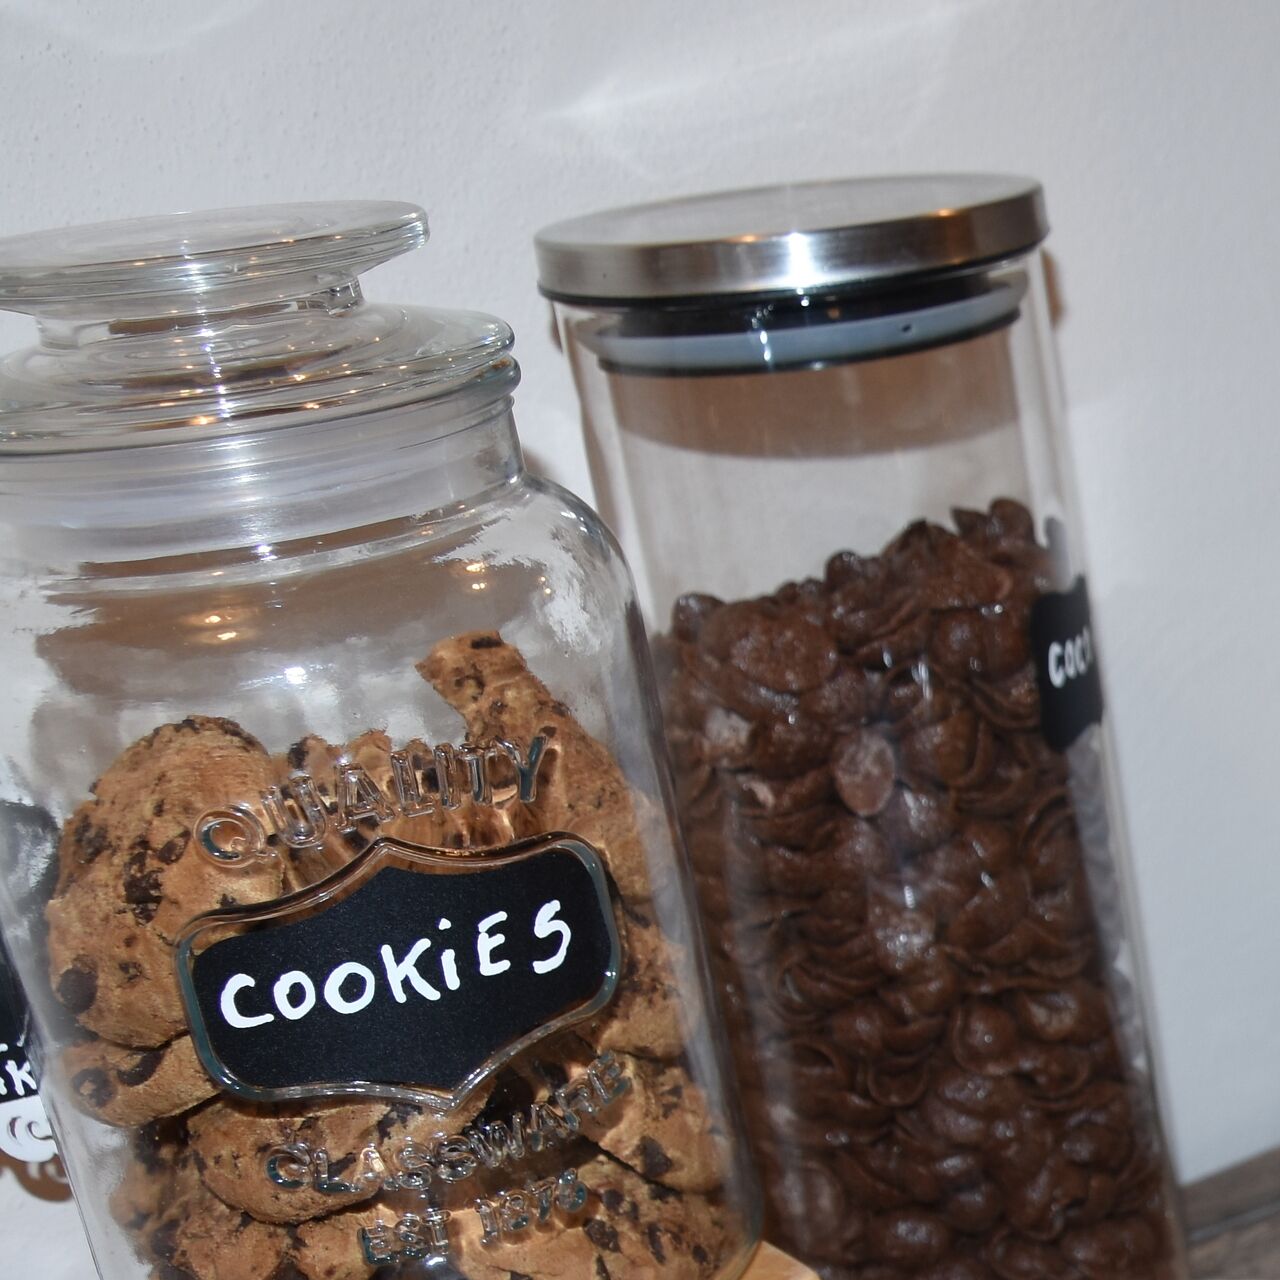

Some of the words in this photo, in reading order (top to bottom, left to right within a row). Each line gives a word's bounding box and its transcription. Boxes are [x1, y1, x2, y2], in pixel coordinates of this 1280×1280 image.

[193, 734, 550, 869] QUALITY
[264, 1050, 632, 1190] GLASSWARE
[357, 1205, 453, 1266] EST
